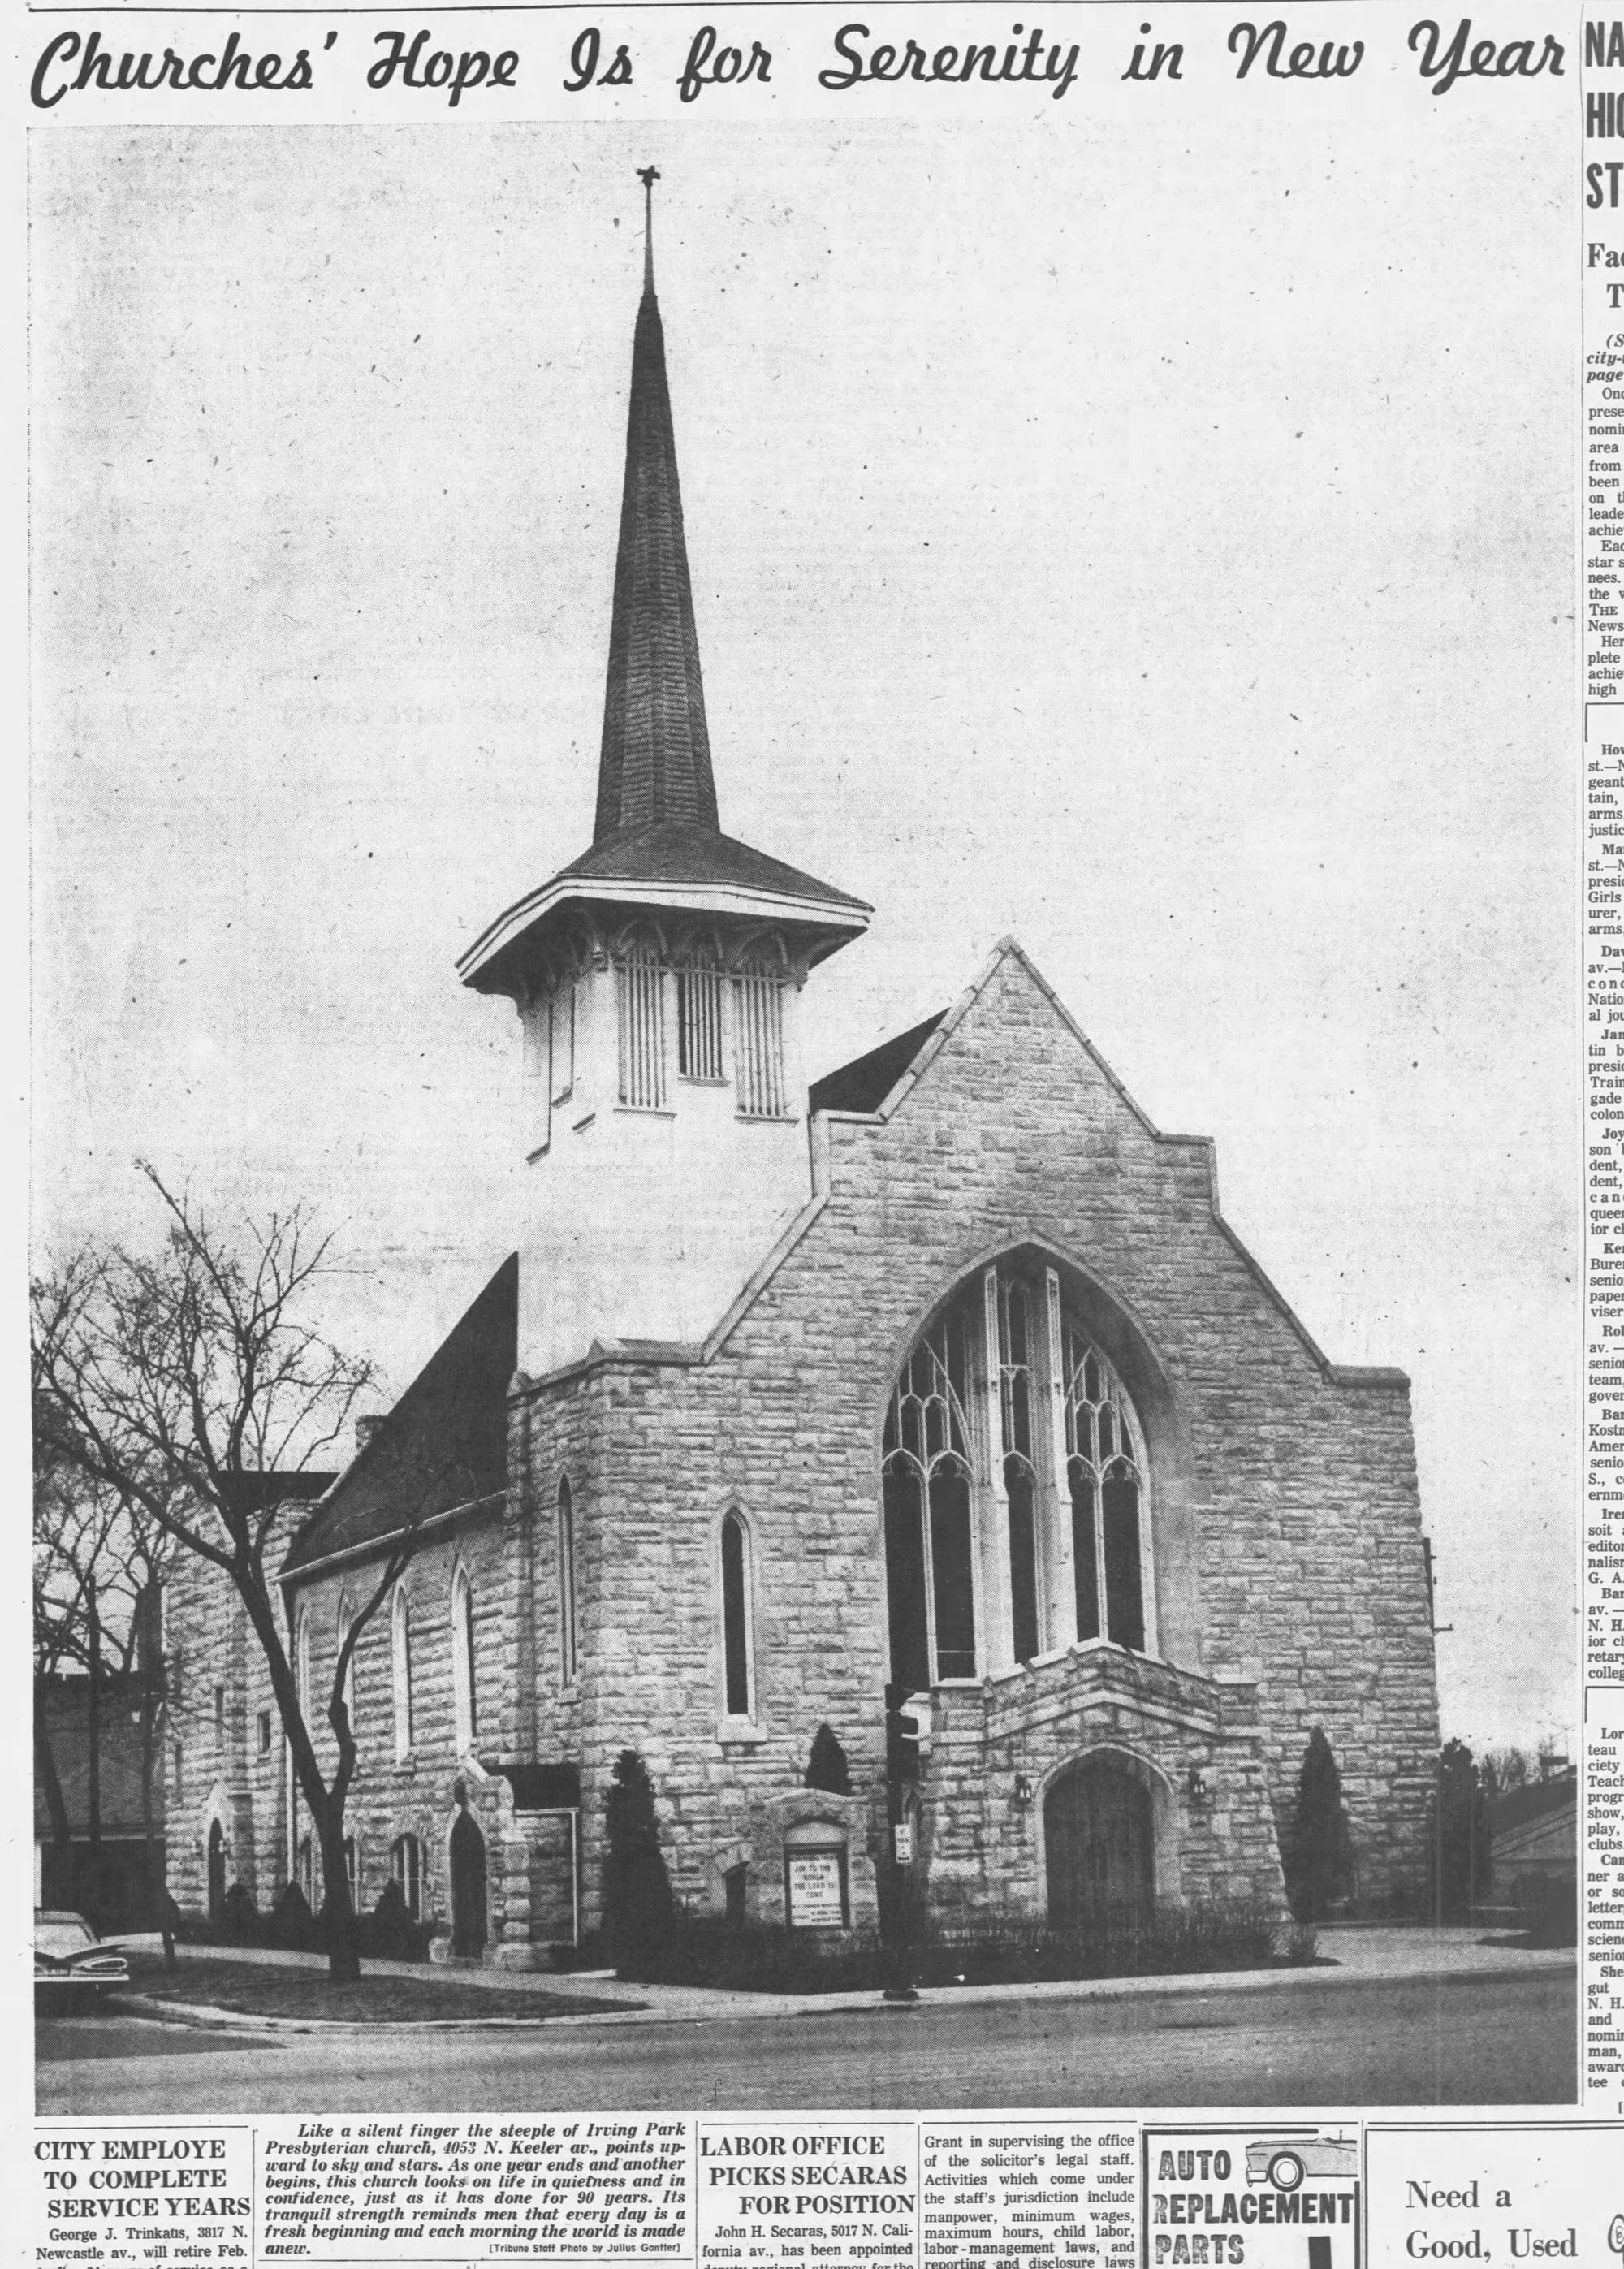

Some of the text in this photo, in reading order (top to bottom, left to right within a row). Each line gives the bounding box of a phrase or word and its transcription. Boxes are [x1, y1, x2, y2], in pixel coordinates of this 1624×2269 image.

[31, 19, 1564, 108] Churches' Hope Is for Serenity in New Year
[1590, 444, 1618, 452] area
[1590, 460, 1621, 471] from
[1589, 477, 1619, 487] been
[1589, 575, 1620, 583] nees.
[1589, 588, 1609, 599] the
[1589, 604, 1618, 615] THE
[1589, 684, 1616, 697] high
[1589, 794, 1617, 806] tain,
[1589, 892, 1621, 902] Girls
[1589, 1983, 1609, 1995] gut
[1589, 2013, 1611, 2025] and
[298, 2123, 685, 2139] Like a silent finger the steeple of Irving Park
[35, 2140, 225, 2160] CITY EMPLOYE
[266, 2141, 685, 2156] Presbyterian church, 4053 N. Keeler av., points up-
[701, 2137, 884, 2156] LABOR OFFICE
[925, 2134, 1134, 2150] Grant in supervising the office
[266, 2157, 685, 2173] ward to sky and stars. As one year ends and another
[1159, 2150, 1231, 2180] AUTO
[44, 2169, 226, 2189] TO COMPLETE
[266, 2174, 685, 2190] begins, this church looks on life in quietness and in
[710, 2166, 906, 2185] PICKS SECARAS
[266, 2190, 685, 2206] confidence, just as it has done for 90 years. Its
[1406, 2181, 1511, 2207] Need a
[49, 2198, 250, 2218] SERVICE YEARS
[740, 2195, 915, 2214] FOR POSITION
[1153, 2193, 1354, 2224] REPLACEMENT
[266, 2207, 685, 2223] tranquil strength reminds men that every day is a
[50, 2229, 97, 2242] George
[105, 2228, 117, 2240] J.
[198, 2227, 224, 2237] 3817
[233, 2226, 247, 2237] N.
[265, 2224, 685, 2240] fresh beginning and each morning the world is made
[715, 2224, 913, 2238] John H. Secaras, 5017 N. Cali-
[37, 2245, 247, 2260] Newcastle av., will retire Feb.
[266, 2245, 310, 2254] anew.
[533, 2244, 555, 2252] Staff
[607, 2244, 636, 2252] Julius
[702, 2243, 913, 2258] fornia av., has been appointed
[1156, 2234, 1243, 2264] PARTS
[1406, 2229, 1577, 2262] Good, Used
